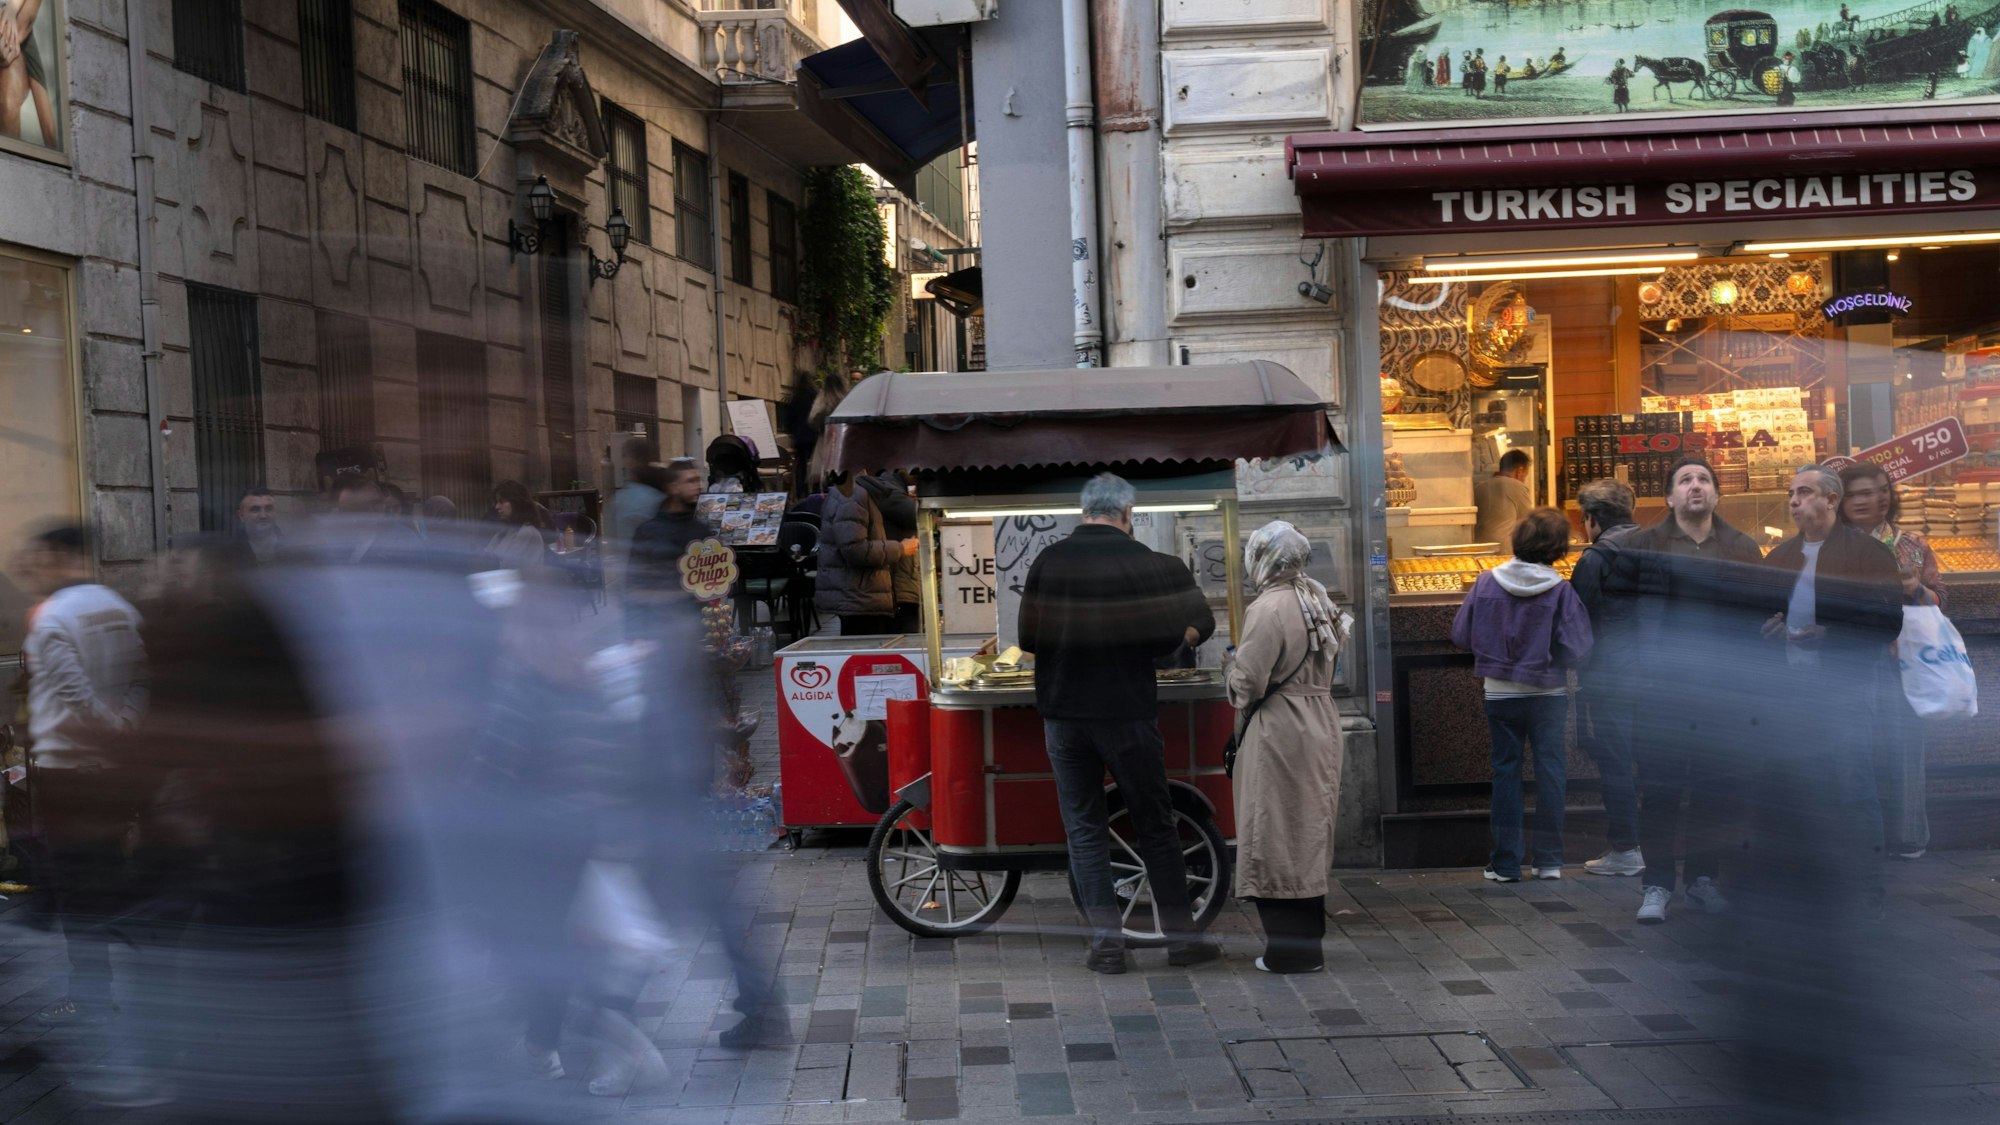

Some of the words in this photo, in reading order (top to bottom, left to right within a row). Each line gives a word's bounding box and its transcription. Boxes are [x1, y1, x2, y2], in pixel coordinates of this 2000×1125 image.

[1432, 185, 1636, 223] TURKISH
[1665, 170, 1977, 215] SPECIALITIES
[1825, 292, 1913, 318] HOŞGELDİNİZ
[1617, 429, 1779, 454] KOSKA
[1911, 427, 1951, 454] 750
[686, 551, 728, 570] Chupa
[687, 565, 730, 586] Chups
